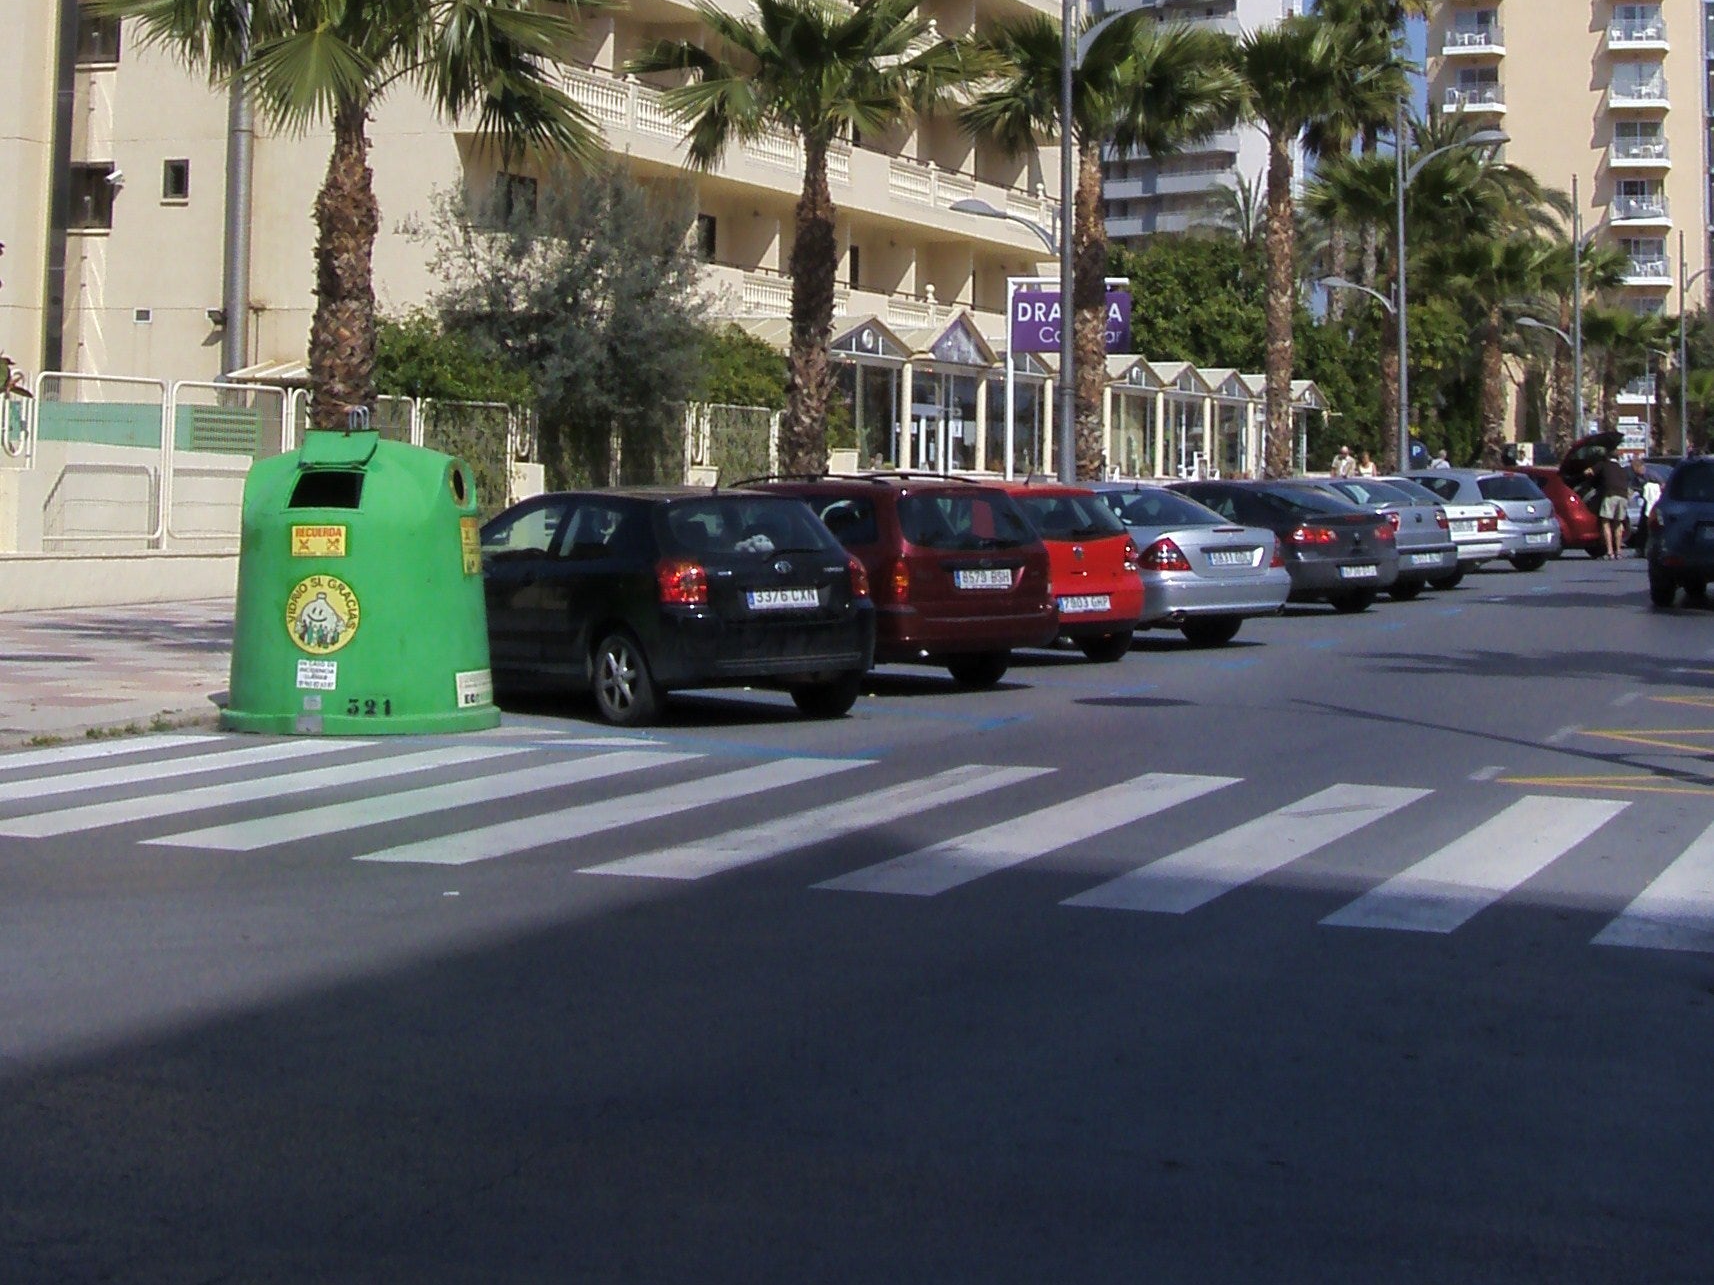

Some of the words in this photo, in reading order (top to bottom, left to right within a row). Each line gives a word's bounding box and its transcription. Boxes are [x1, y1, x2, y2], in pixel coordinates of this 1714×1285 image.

[295, 527, 342, 538] RECUERDA
[756, 590, 789, 603] 3376
[791, 589, 816, 602] CXN
[327, 578, 358, 630] GRACIAS
